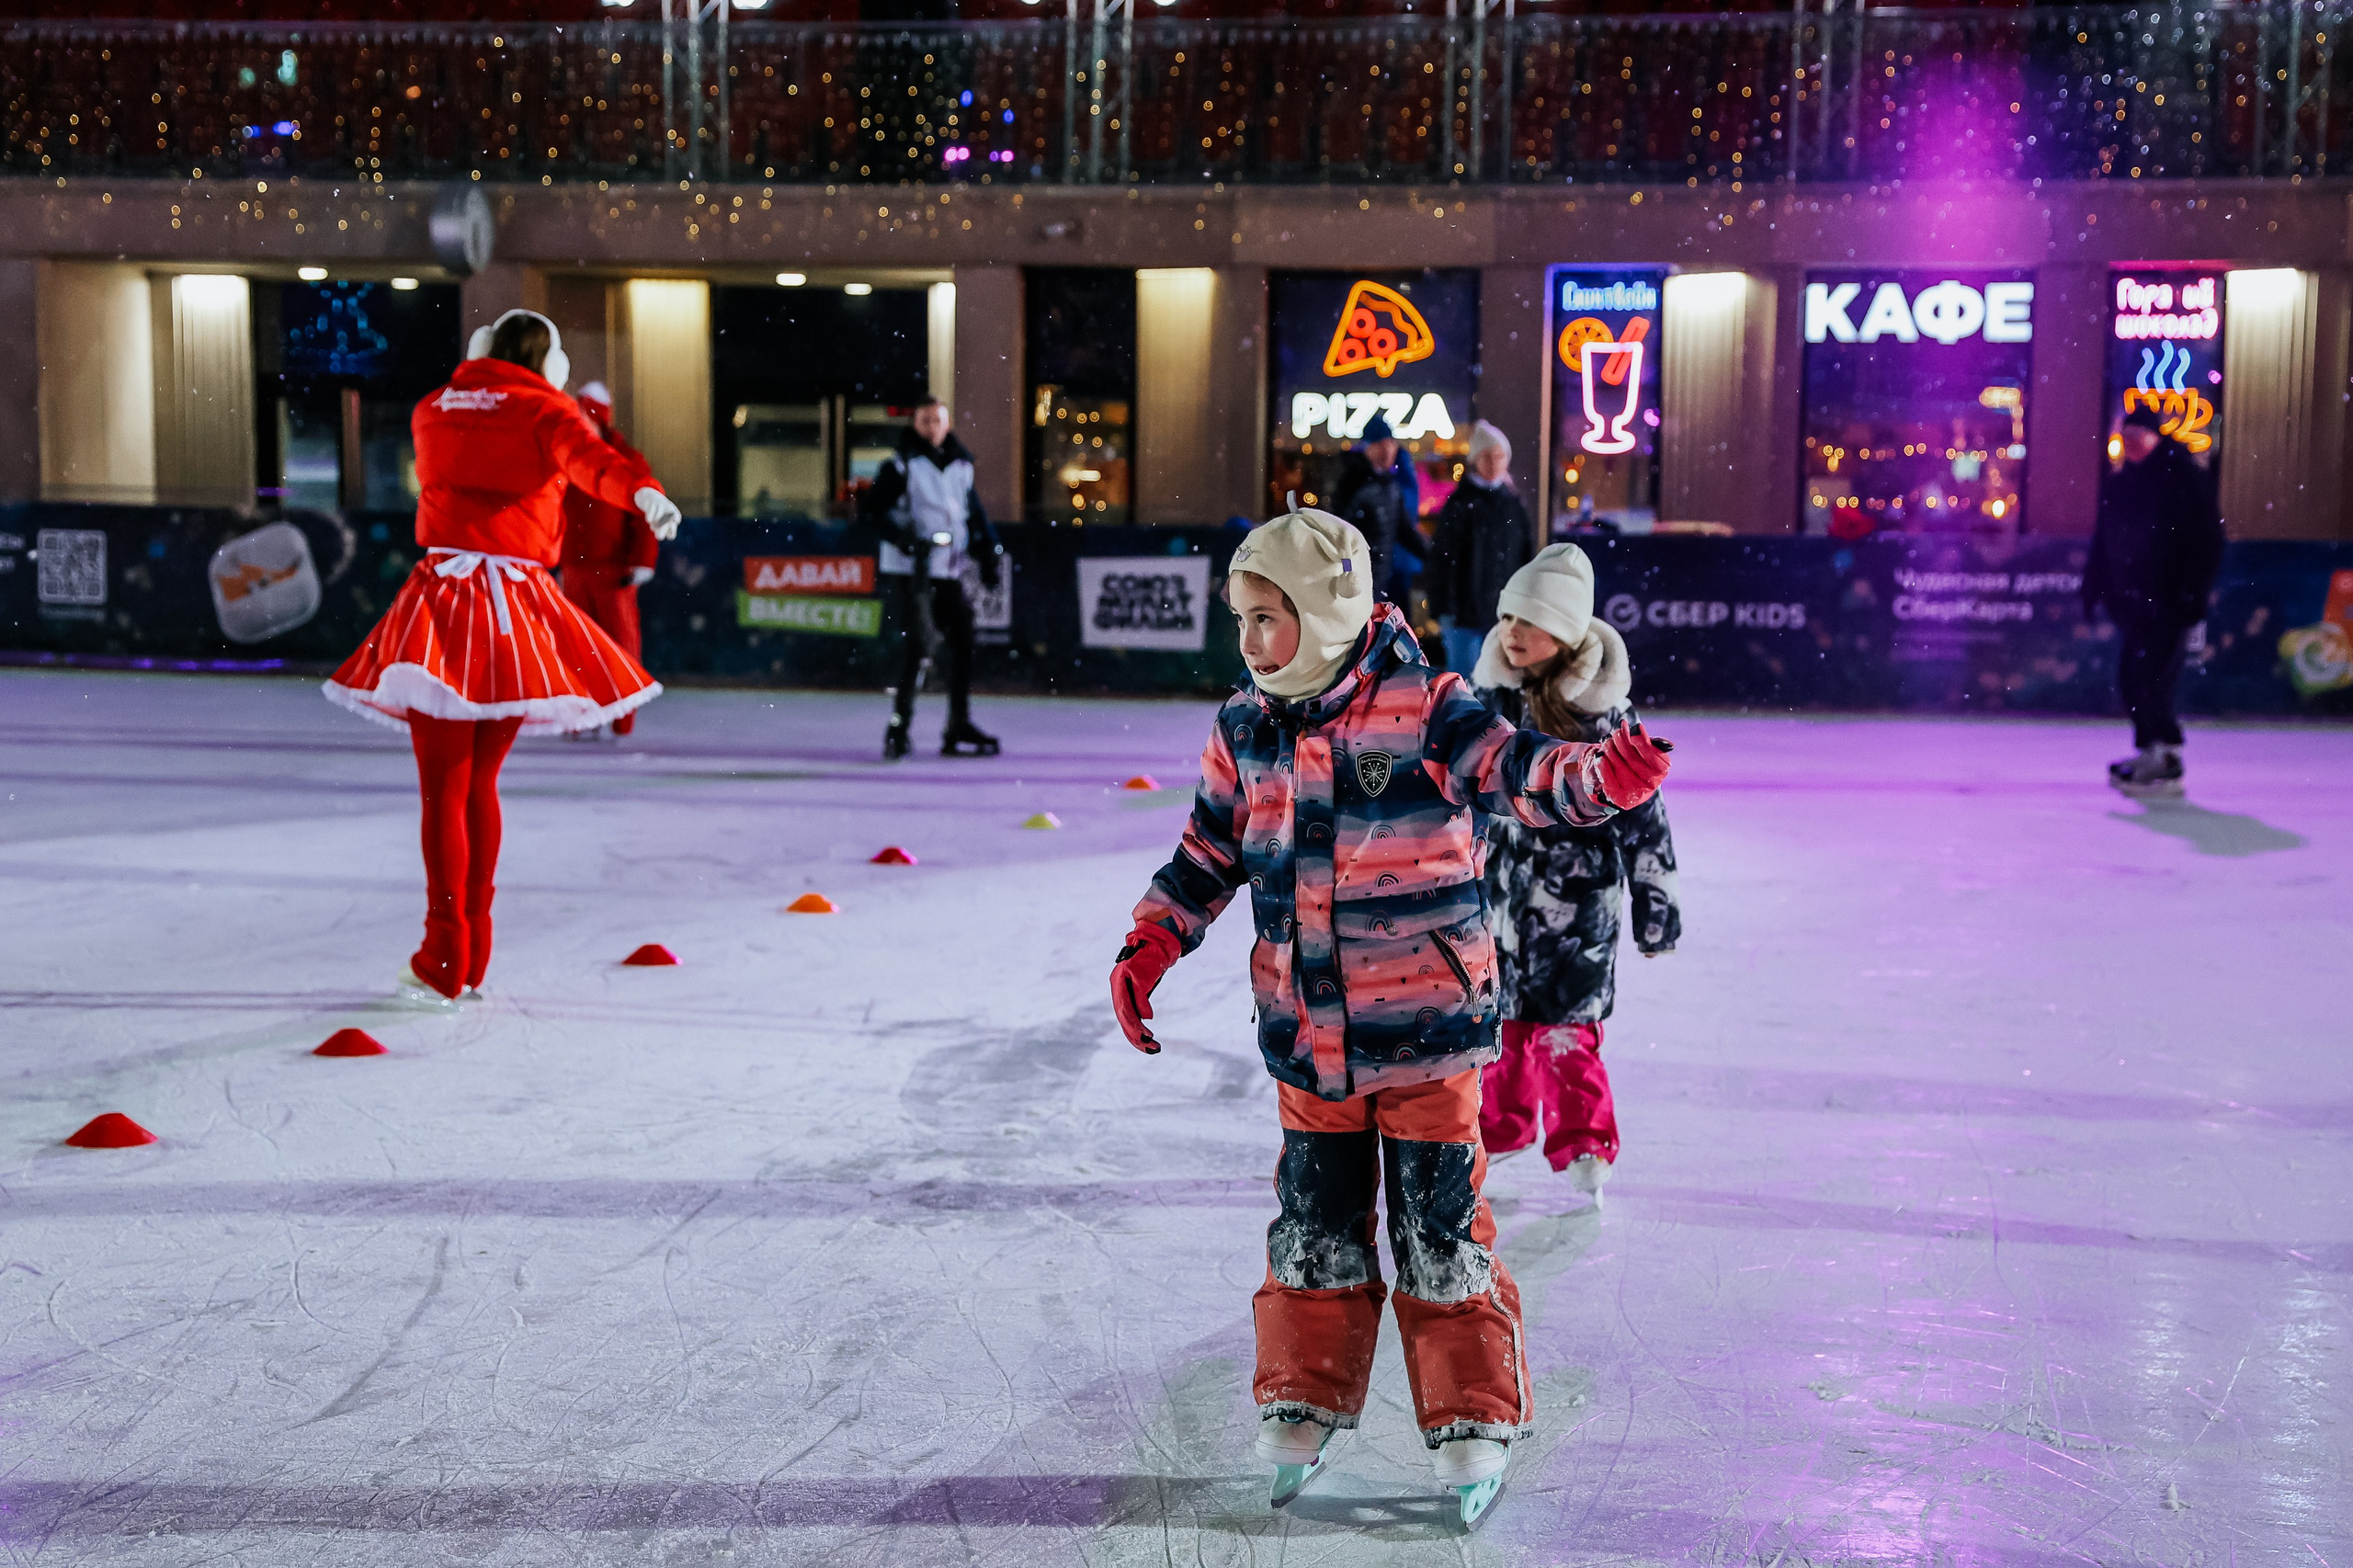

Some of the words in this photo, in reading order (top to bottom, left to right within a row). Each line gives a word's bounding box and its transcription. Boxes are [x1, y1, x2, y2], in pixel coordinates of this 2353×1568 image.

[1804, 280, 2034, 345] КАФЕ
[2117, 278, 2215, 314] Горяий
[2115, 308, 2218, 340] шоколад
[1292, 392, 1455, 439] PIZZA
[754, 561, 862, 589] ДАВАЙ
[1647, 600, 1730, 628] СБЕР
[1734, 602, 1807, 630] KIDS
